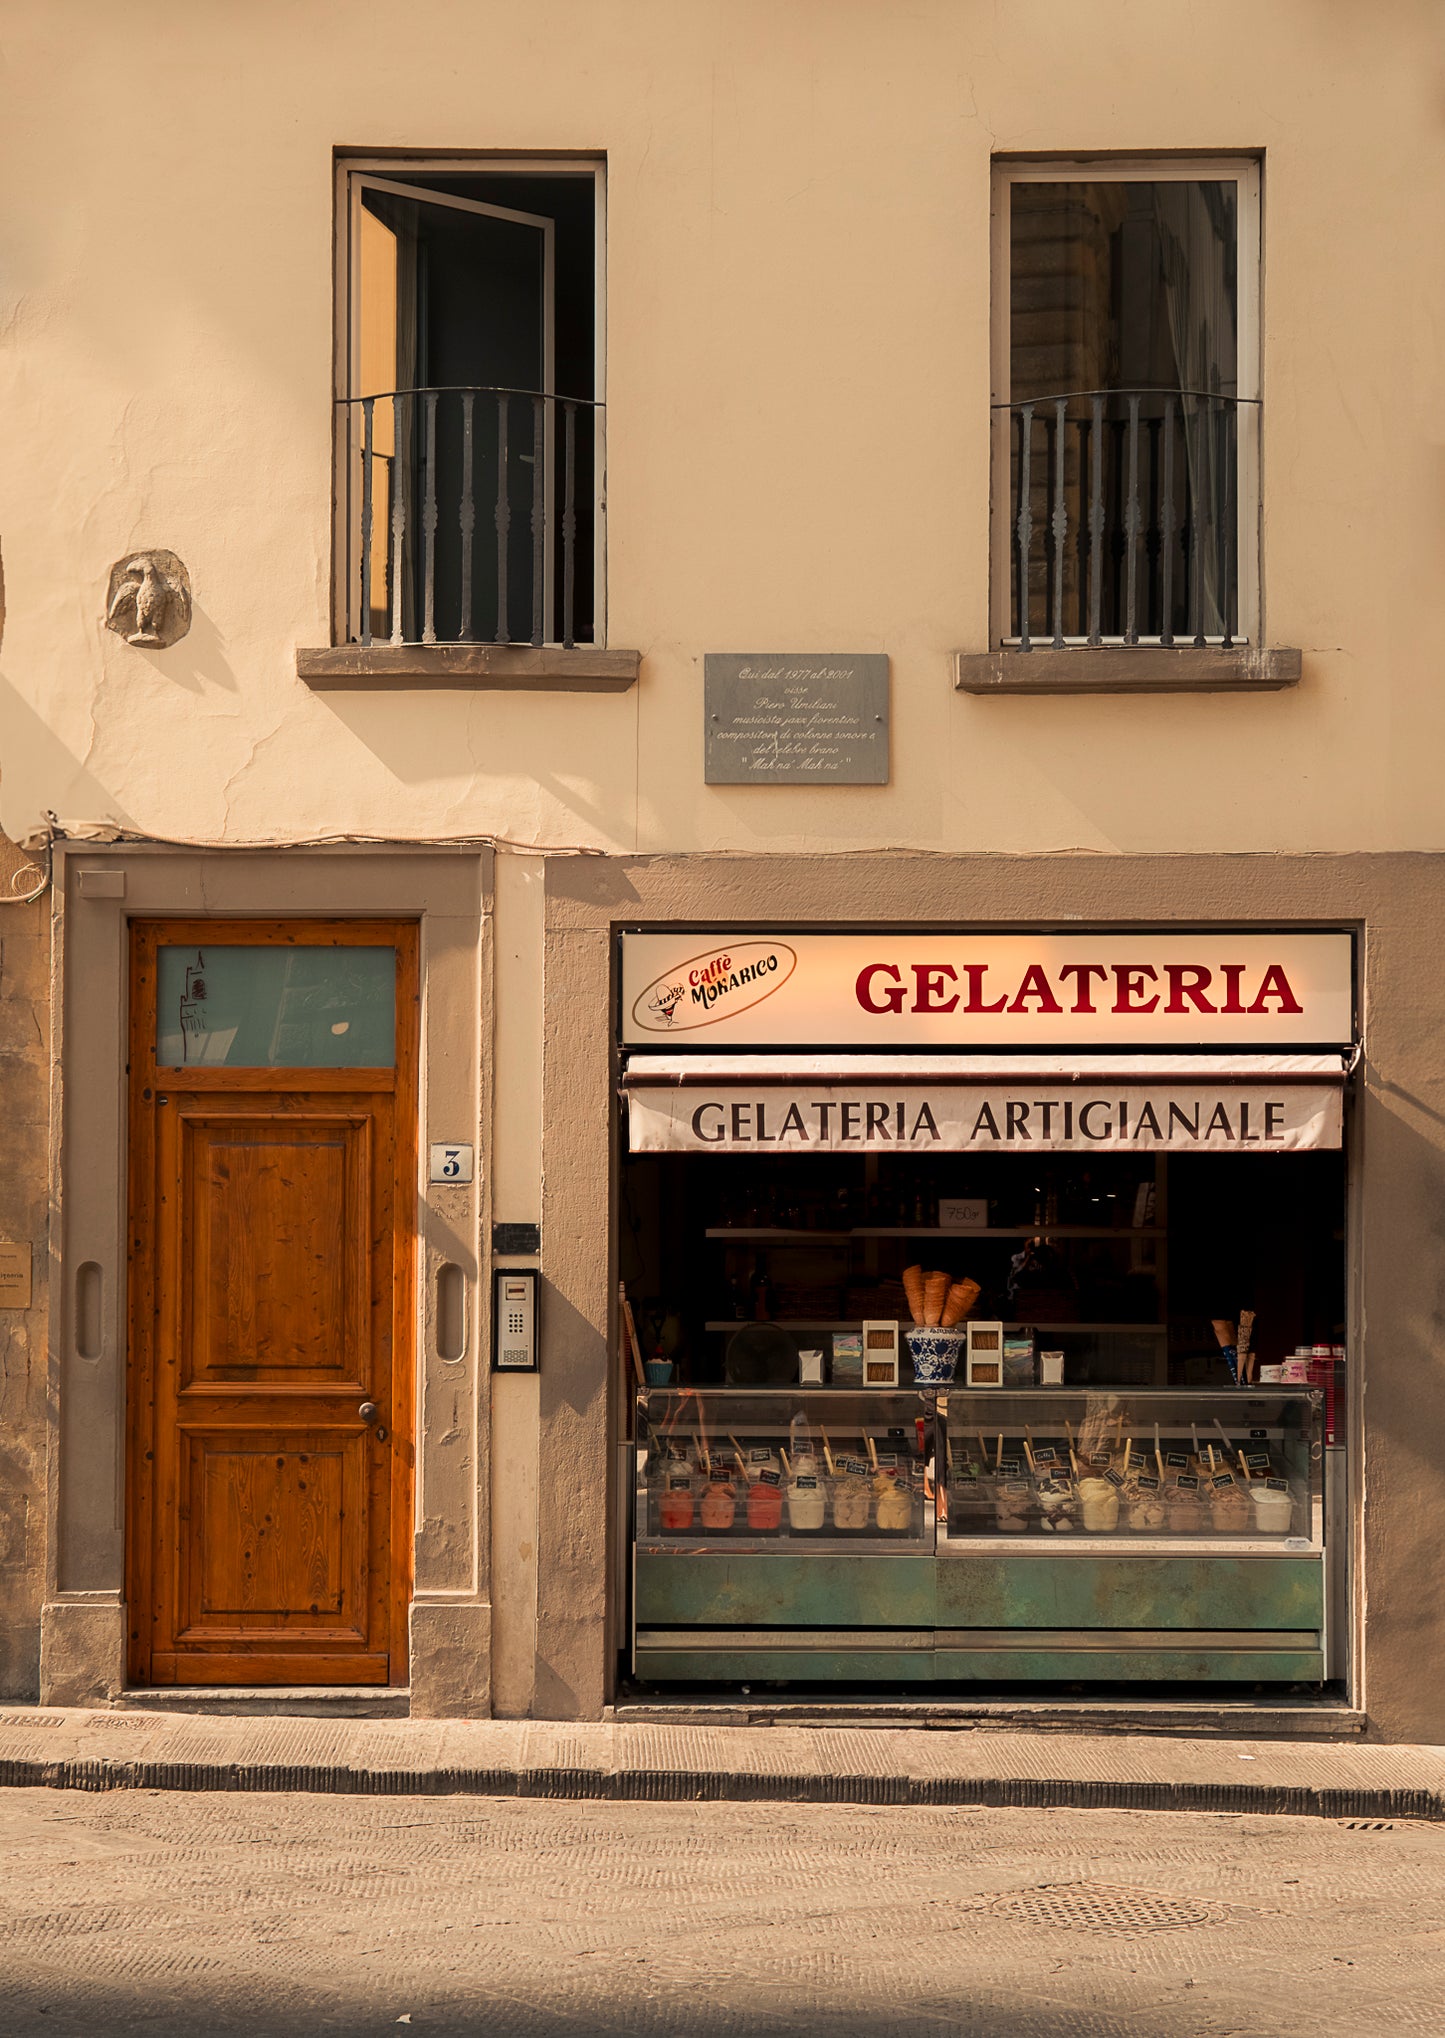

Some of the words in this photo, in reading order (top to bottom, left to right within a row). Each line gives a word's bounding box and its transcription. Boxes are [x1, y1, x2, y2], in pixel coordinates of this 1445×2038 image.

[738, 667, 760, 680] Qui
[761, 667, 785, 680] dal
[785, 669, 811, 681] 1977
[810, 667, 826, 680] al
[826, 669, 854, 680] 2001
[784, 686, 808, 695] visse
[753, 697, 785, 710] Piero
[789, 697, 839, 710] Umiliani
[733, 715, 781, 725] musicista
[780, 715, 807, 727] jazz
[806, 711, 860, 727] fiorentino
[716, 730, 778, 742] compositore
[780, 728, 791, 740] di
[793, 727, 833, 740] colonne
[834, 732, 866, 740] sonore
[753, 743, 774, 754] del
[808, 742, 839, 754] brano
[688, 954, 732, 987] Caffè
[855, 963, 1304, 1014] GELATERIA
[691, 1101, 943, 1142] GELATERIA
[970, 1100, 1285, 1142] ARTIGIANALE
[443, 1151, 460, 1177] 3
